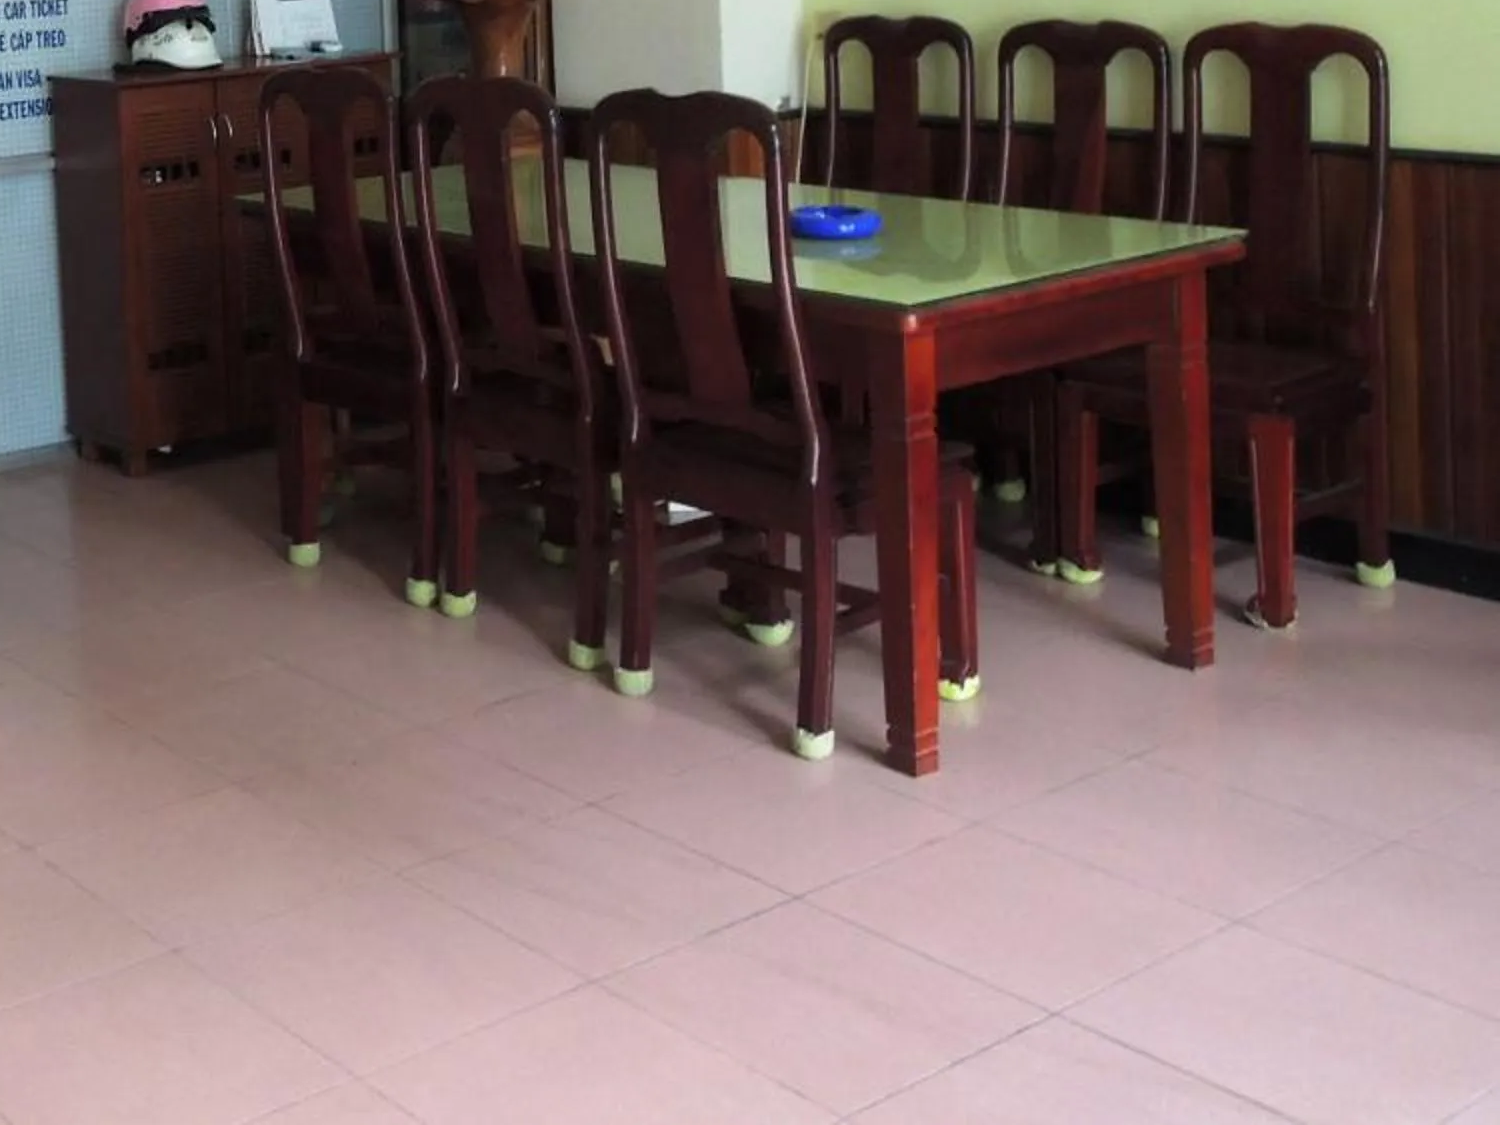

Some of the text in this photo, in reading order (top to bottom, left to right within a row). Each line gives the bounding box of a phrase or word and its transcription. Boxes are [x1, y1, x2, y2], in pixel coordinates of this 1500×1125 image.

[4, 0, 27, 21] CAR
[36, 29, 66, 48] TREO
[16, 68, 42, 89] VISA
[0, 97, 53, 120] EXTENSIO
